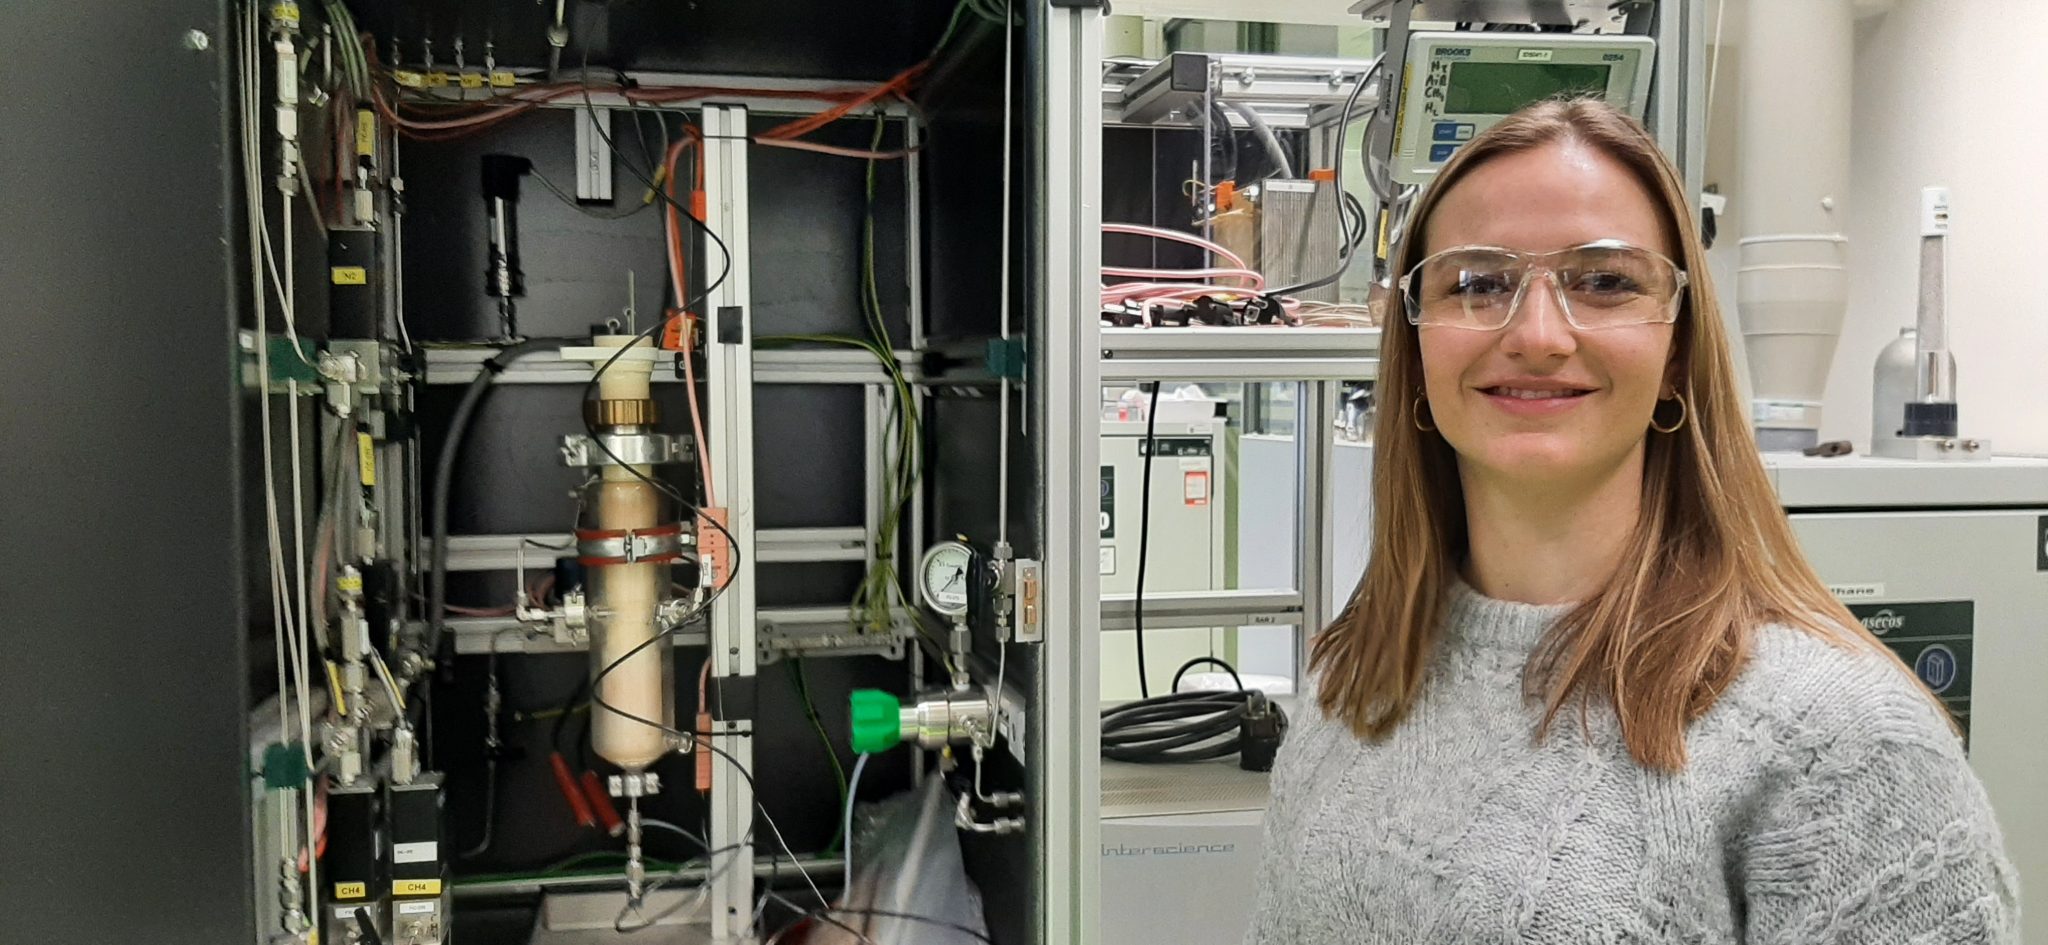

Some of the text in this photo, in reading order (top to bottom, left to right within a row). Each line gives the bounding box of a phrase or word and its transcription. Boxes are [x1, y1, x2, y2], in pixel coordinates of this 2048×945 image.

[1435, 47, 1471, 56] BROOKS
[1861, 613, 1905, 630] asecos
[1101, 843, 1235, 856] Interscience
[341, 887, 360, 895] CH4
[407, 883, 427, 891] CH4
